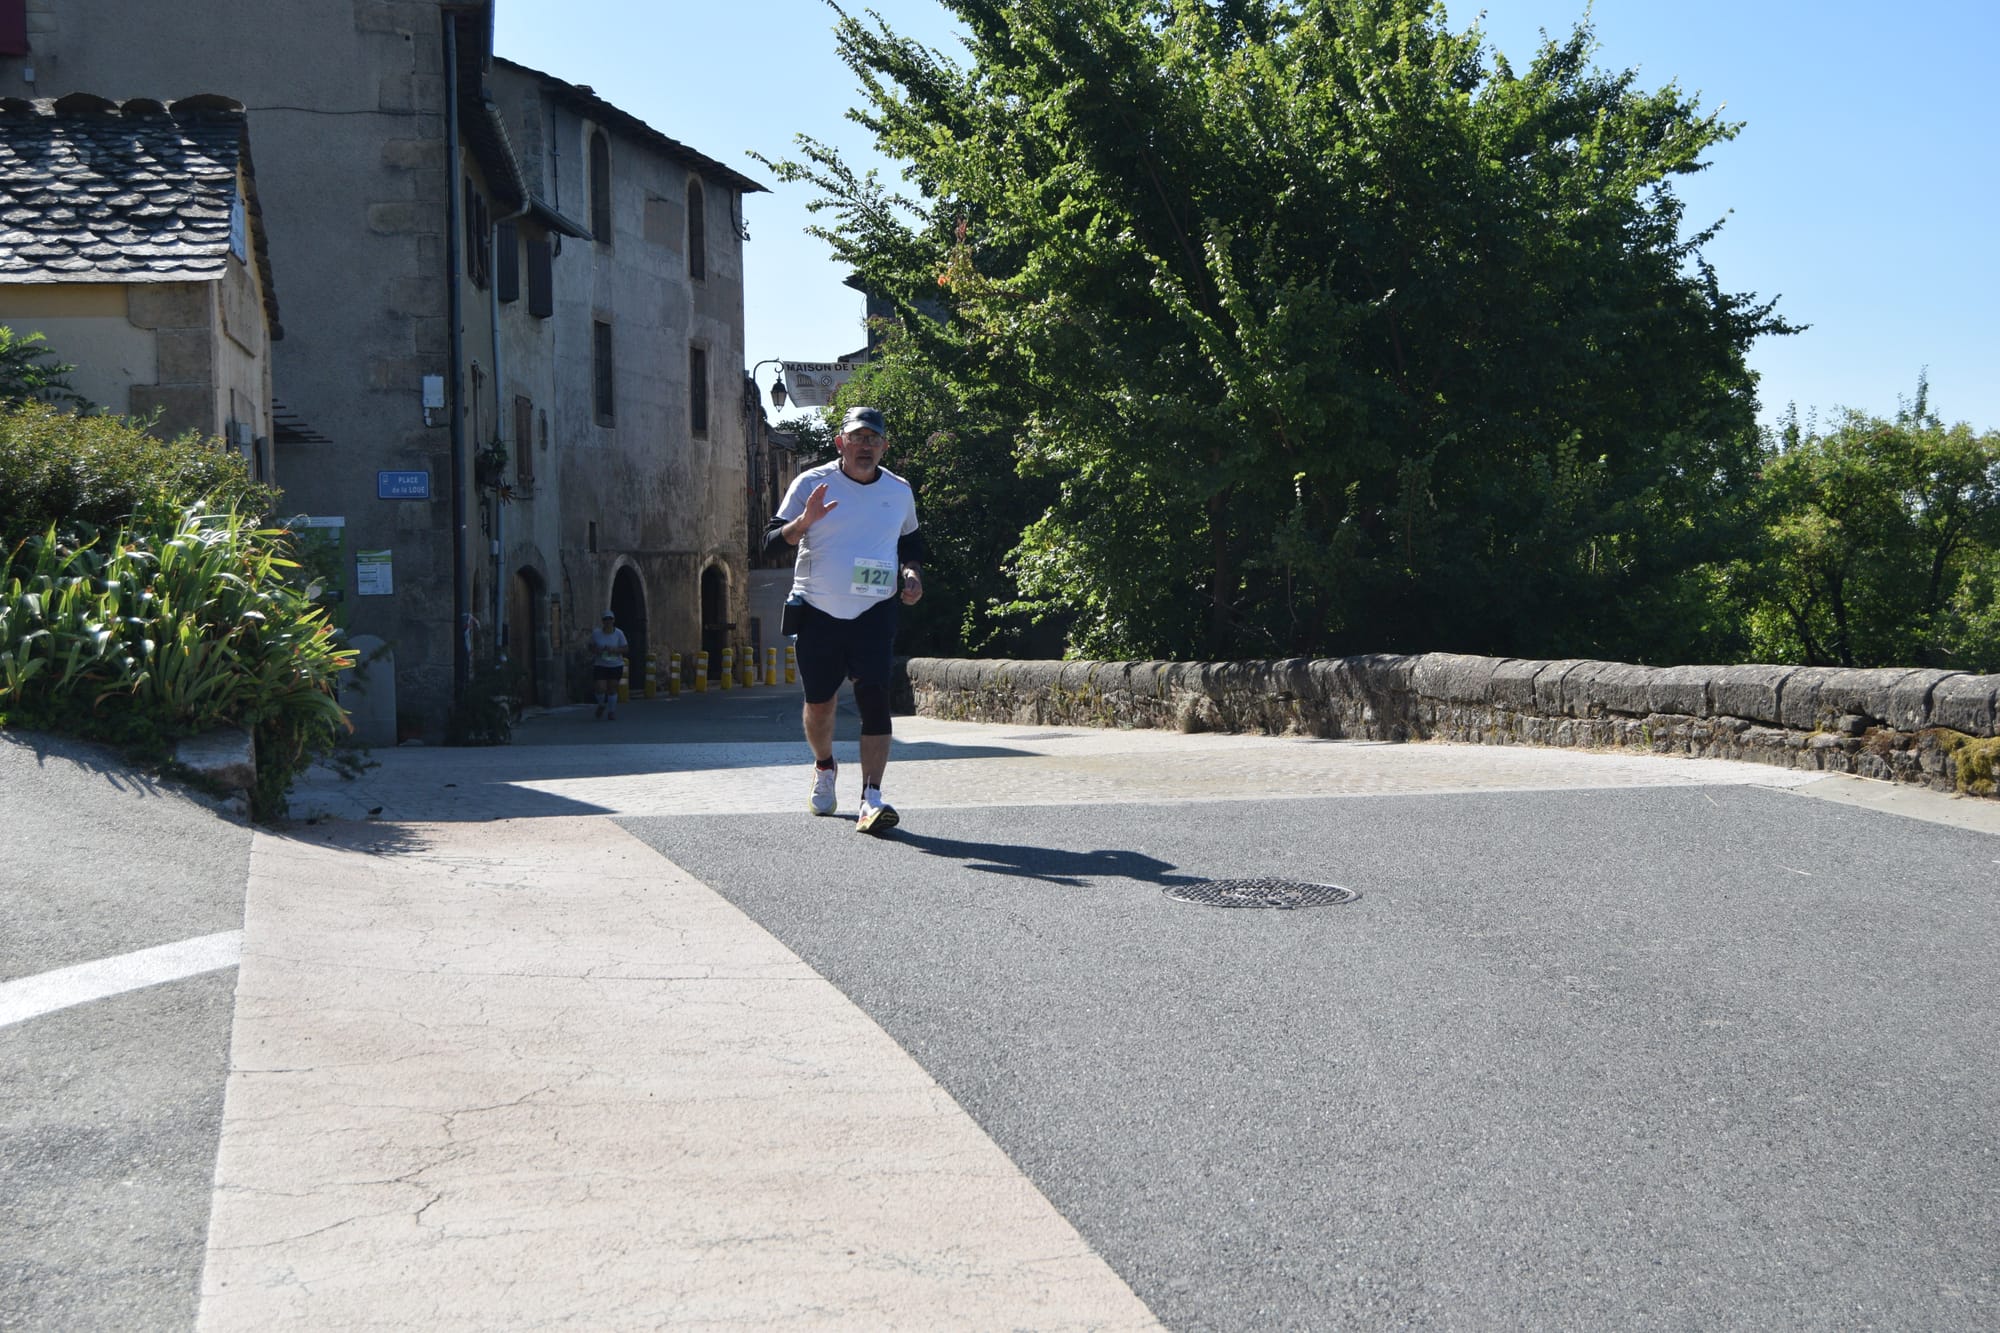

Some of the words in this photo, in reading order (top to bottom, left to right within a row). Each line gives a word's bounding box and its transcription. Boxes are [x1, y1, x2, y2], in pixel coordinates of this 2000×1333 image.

[786, 363, 832, 372] MAISON
[834, 363, 849, 371] DE
[398, 476, 418, 484] PLACE
[861, 569, 890, 585] 127
